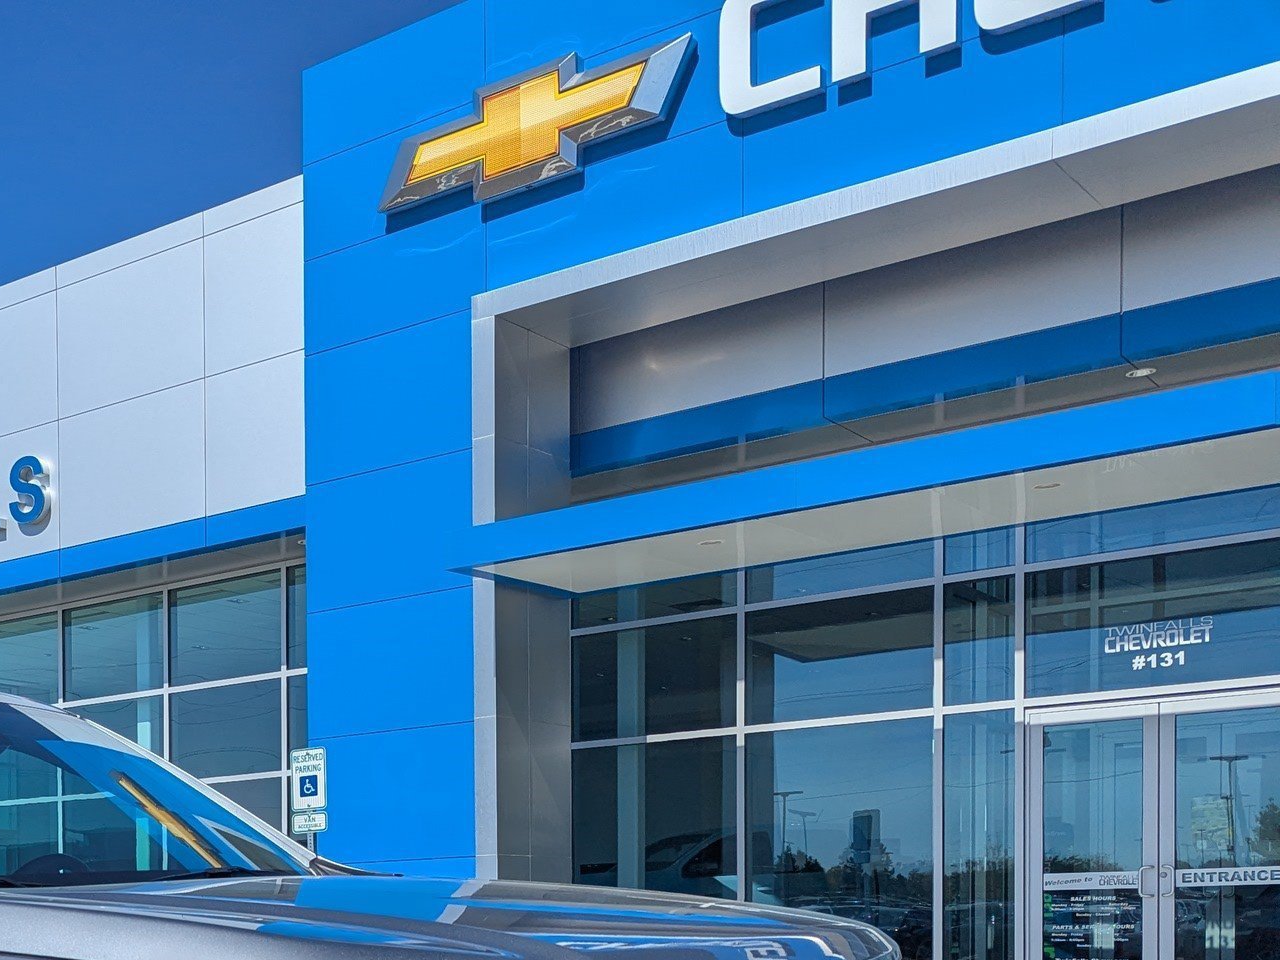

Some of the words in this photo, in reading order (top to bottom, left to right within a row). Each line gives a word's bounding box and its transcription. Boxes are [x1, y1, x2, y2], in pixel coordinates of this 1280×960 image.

[1104, 615, 1214, 637] TWINFALLS
[1104, 625, 1214, 654] CHEVROLET
[1132, 650, 1185, 670] #131
[293, 752, 323, 764] RESERVED
[295, 763, 322, 774] PARKING
[1045, 878, 1082, 886] Welcome
[1181, 870, 1280, 883] ENTRANCE
